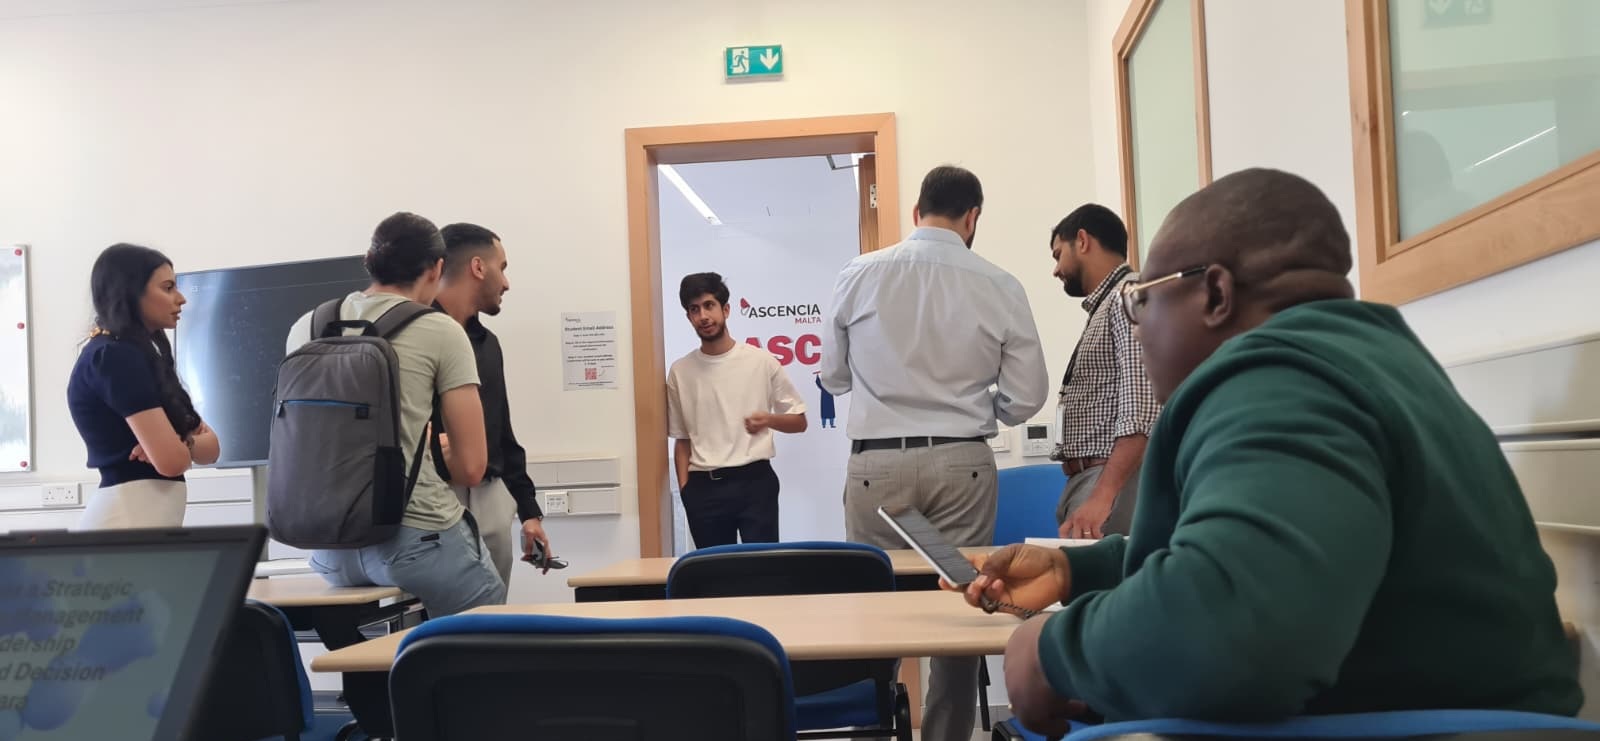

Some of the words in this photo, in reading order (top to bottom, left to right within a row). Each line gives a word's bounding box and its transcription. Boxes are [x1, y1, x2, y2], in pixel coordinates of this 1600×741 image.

[748, 303, 821, 318] ASCENCIA
[745, 333, 822, 366] SC
[42, 578, 134, 600] Strategic
[13, 661, 106, 681] Decision
